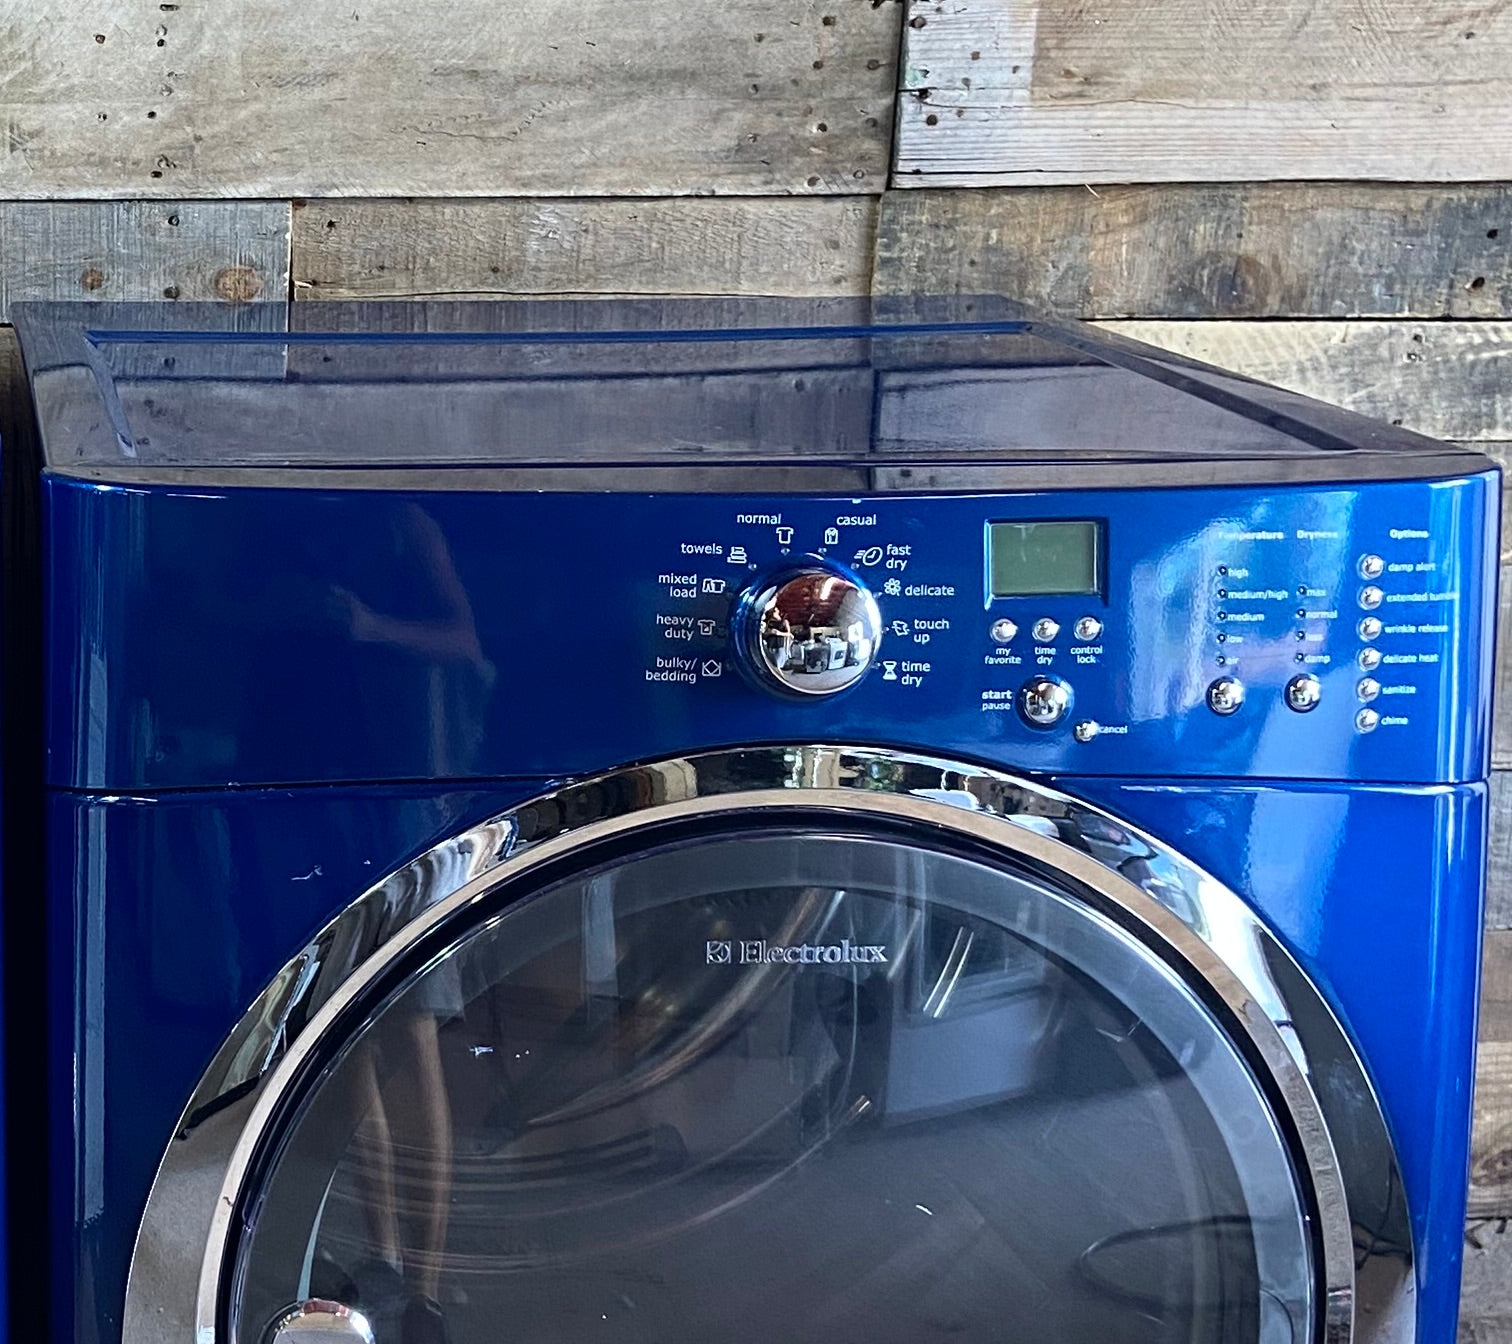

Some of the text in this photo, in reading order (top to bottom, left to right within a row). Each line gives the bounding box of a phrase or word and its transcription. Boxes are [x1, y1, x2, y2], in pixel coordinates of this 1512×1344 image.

[737, 513, 781, 525] normal
[836, 514, 877, 526] casual
[1390, 529, 1429, 540] Options
[681, 543, 723, 555] towels
[886, 544, 911, 556] fast
[886, 557, 908, 571] dry
[658, 573, 697, 585] mixed
[1228, 568, 1248, 578] high
[669, 586, 697, 598] load
[904, 584, 955, 596] delicate
[1228, 589, 1288, 600] medium/high
[656, 614, 694, 628] heavy
[1228, 612, 1264, 621] medium
[914, 618, 949, 630] touch
[664, 627, 694, 641] duty
[914, 633, 930, 644] up
[995, 647, 1011, 656] my
[1034, 646, 1056, 655] time
[1070, 645, 1103, 655] control
[656, 657, 697, 671] bulky/
[985, 655, 1022, 665] favorite
[1037, 655, 1053, 666] dry
[1077, 655, 1096, 664] lock
[901, 660, 931, 673] time
[645, 669, 697, 684] bedding
[901, 673, 923, 687] dry
[982, 689, 1013, 700] start
[982, 702, 1011, 712] pause
[1099, 725, 1128, 734] cancel
[739, 939, 888, 964] Electrolux
